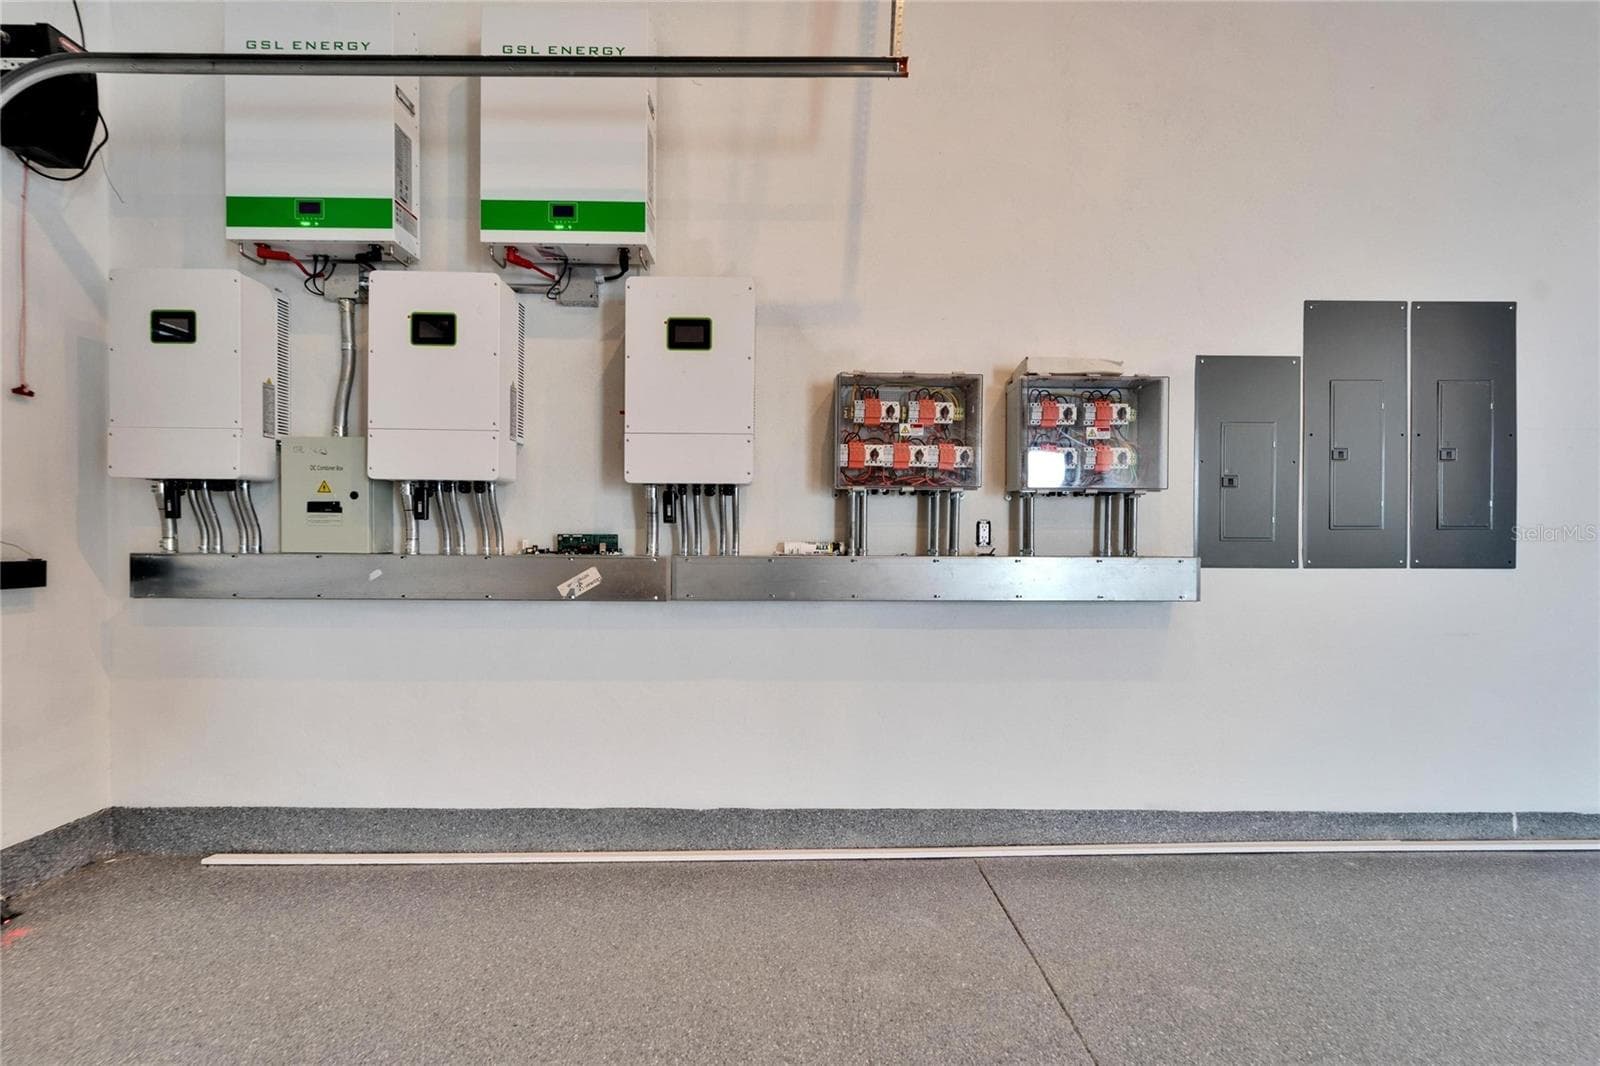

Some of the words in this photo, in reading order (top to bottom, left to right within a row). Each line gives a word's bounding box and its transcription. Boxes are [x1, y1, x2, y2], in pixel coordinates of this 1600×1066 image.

[246, 40, 284, 50] GSL
[292, 41, 370, 51] ENERGY
[502, 45, 539, 54] GSL
[548, 46, 625, 55] ENERGY
